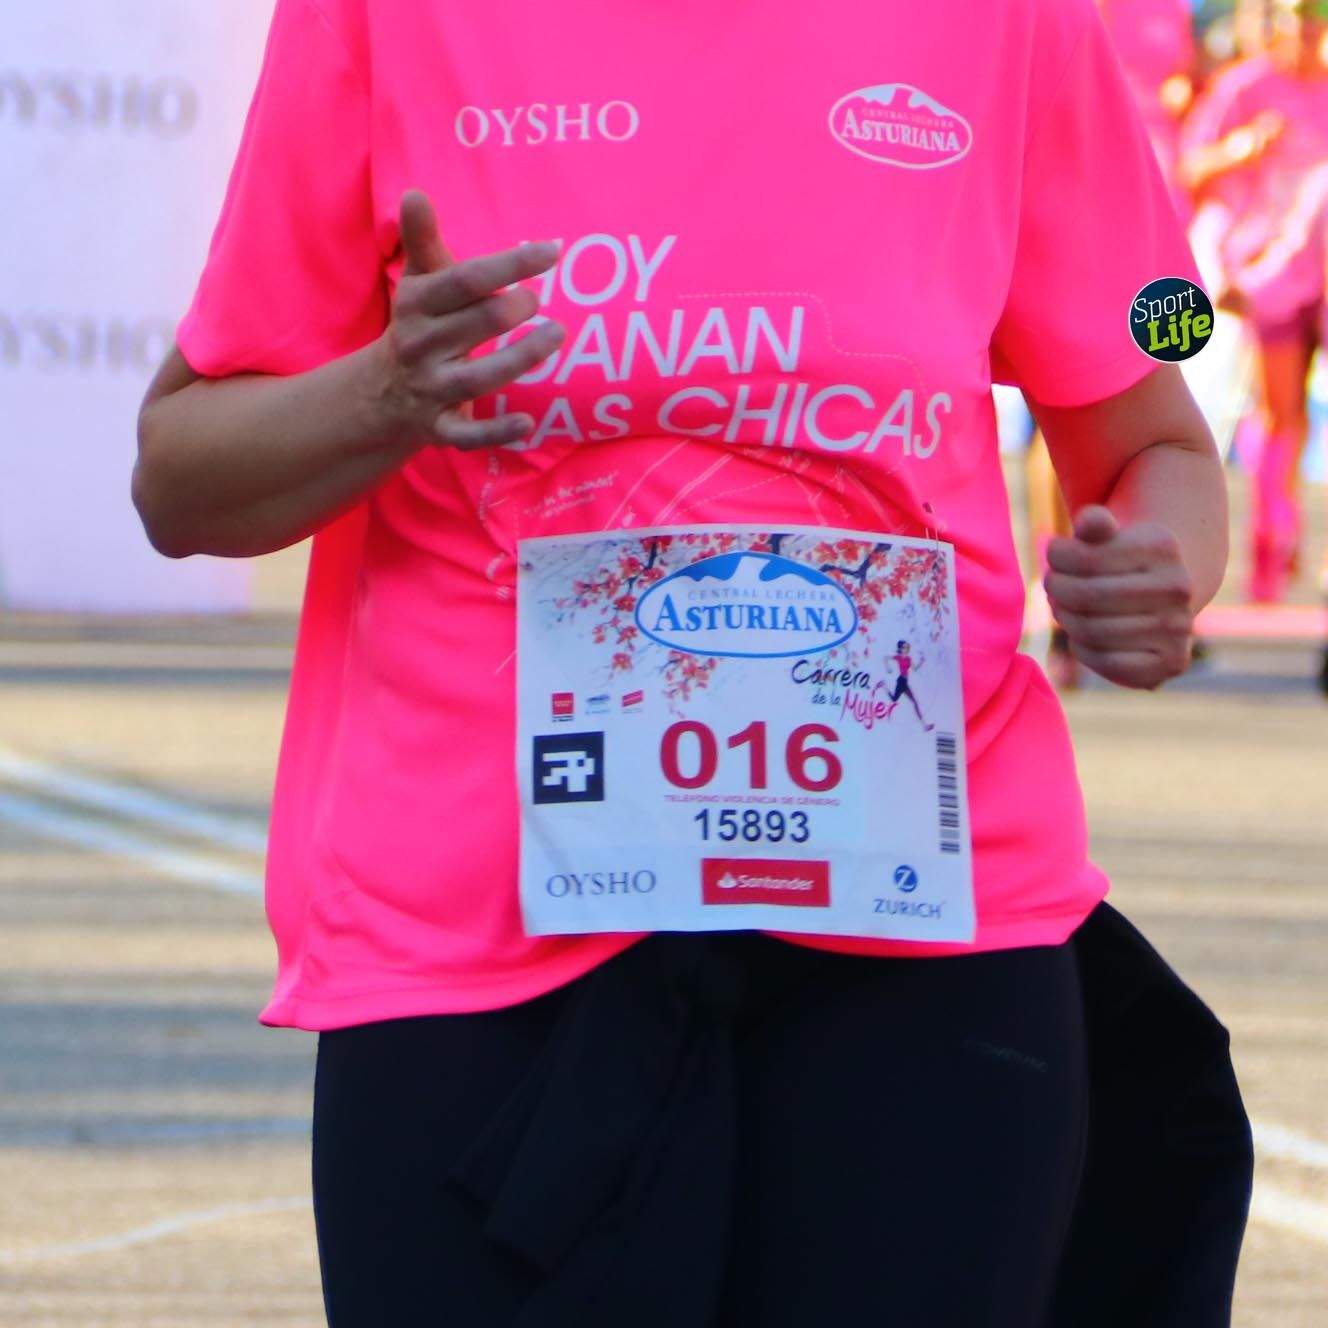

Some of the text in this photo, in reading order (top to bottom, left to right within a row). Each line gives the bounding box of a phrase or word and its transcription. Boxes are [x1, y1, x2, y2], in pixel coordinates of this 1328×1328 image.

[454, 100, 640, 147] OYSHO
[840, 108, 961, 152] ASTURIANA
[657, 383, 952, 459] CHICAS
[652, 593, 843, 634] ASTURIANA
[791, 659, 870, 689] Carrera
[811, 691, 826, 705] de
[840, 690, 900, 730] Mujer
[659, 720, 843, 792] 016
[694, 808, 809, 843] 15893
[546, 870, 657, 897] OYSHO
[737, 875, 814, 891] Santander
[873, 899, 940, 919] ZURICH
